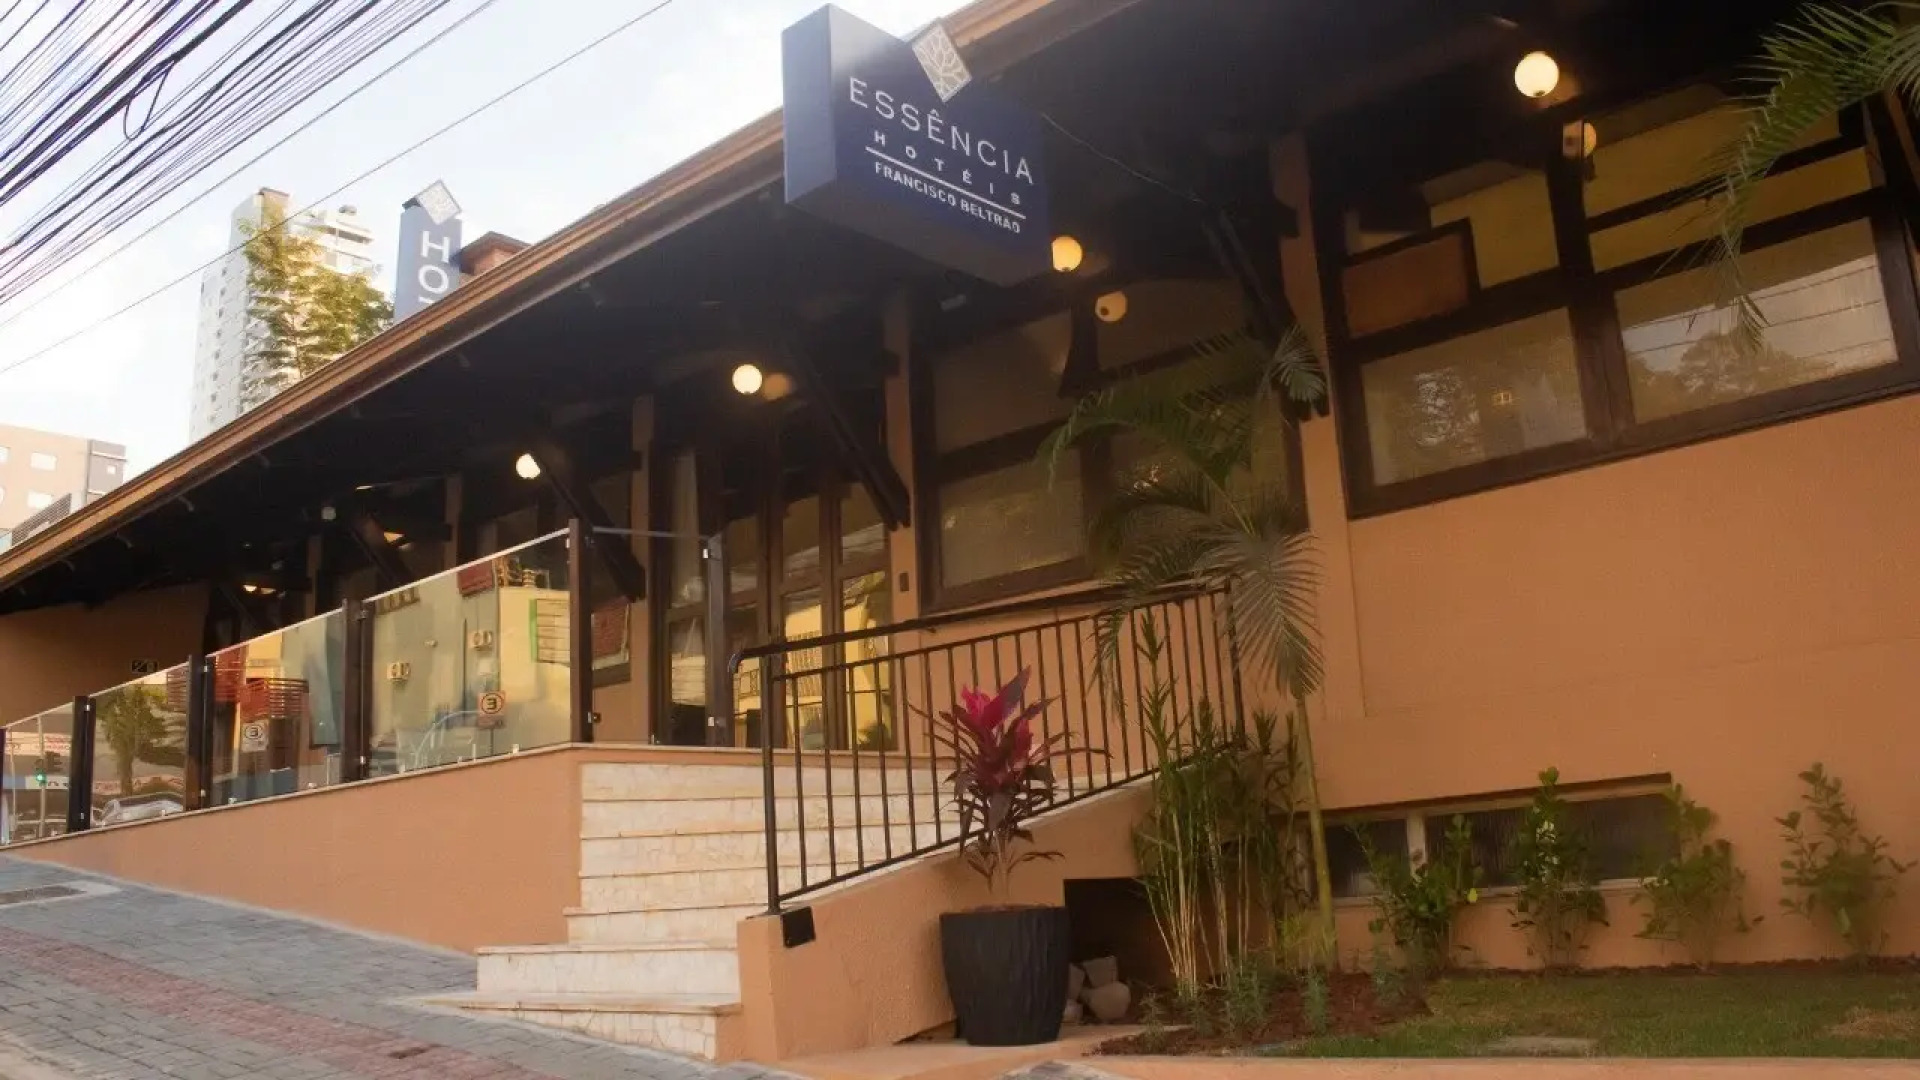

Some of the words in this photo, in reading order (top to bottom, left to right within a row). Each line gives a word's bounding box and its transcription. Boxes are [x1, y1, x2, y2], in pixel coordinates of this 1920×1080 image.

[850, 77, 1033, 185] ESSÊNCIA
[874, 130, 1020, 205] HOTÉIS
[875, 161, 956, 207] FRANCISCO
[418, 230, 450, 304] HO
